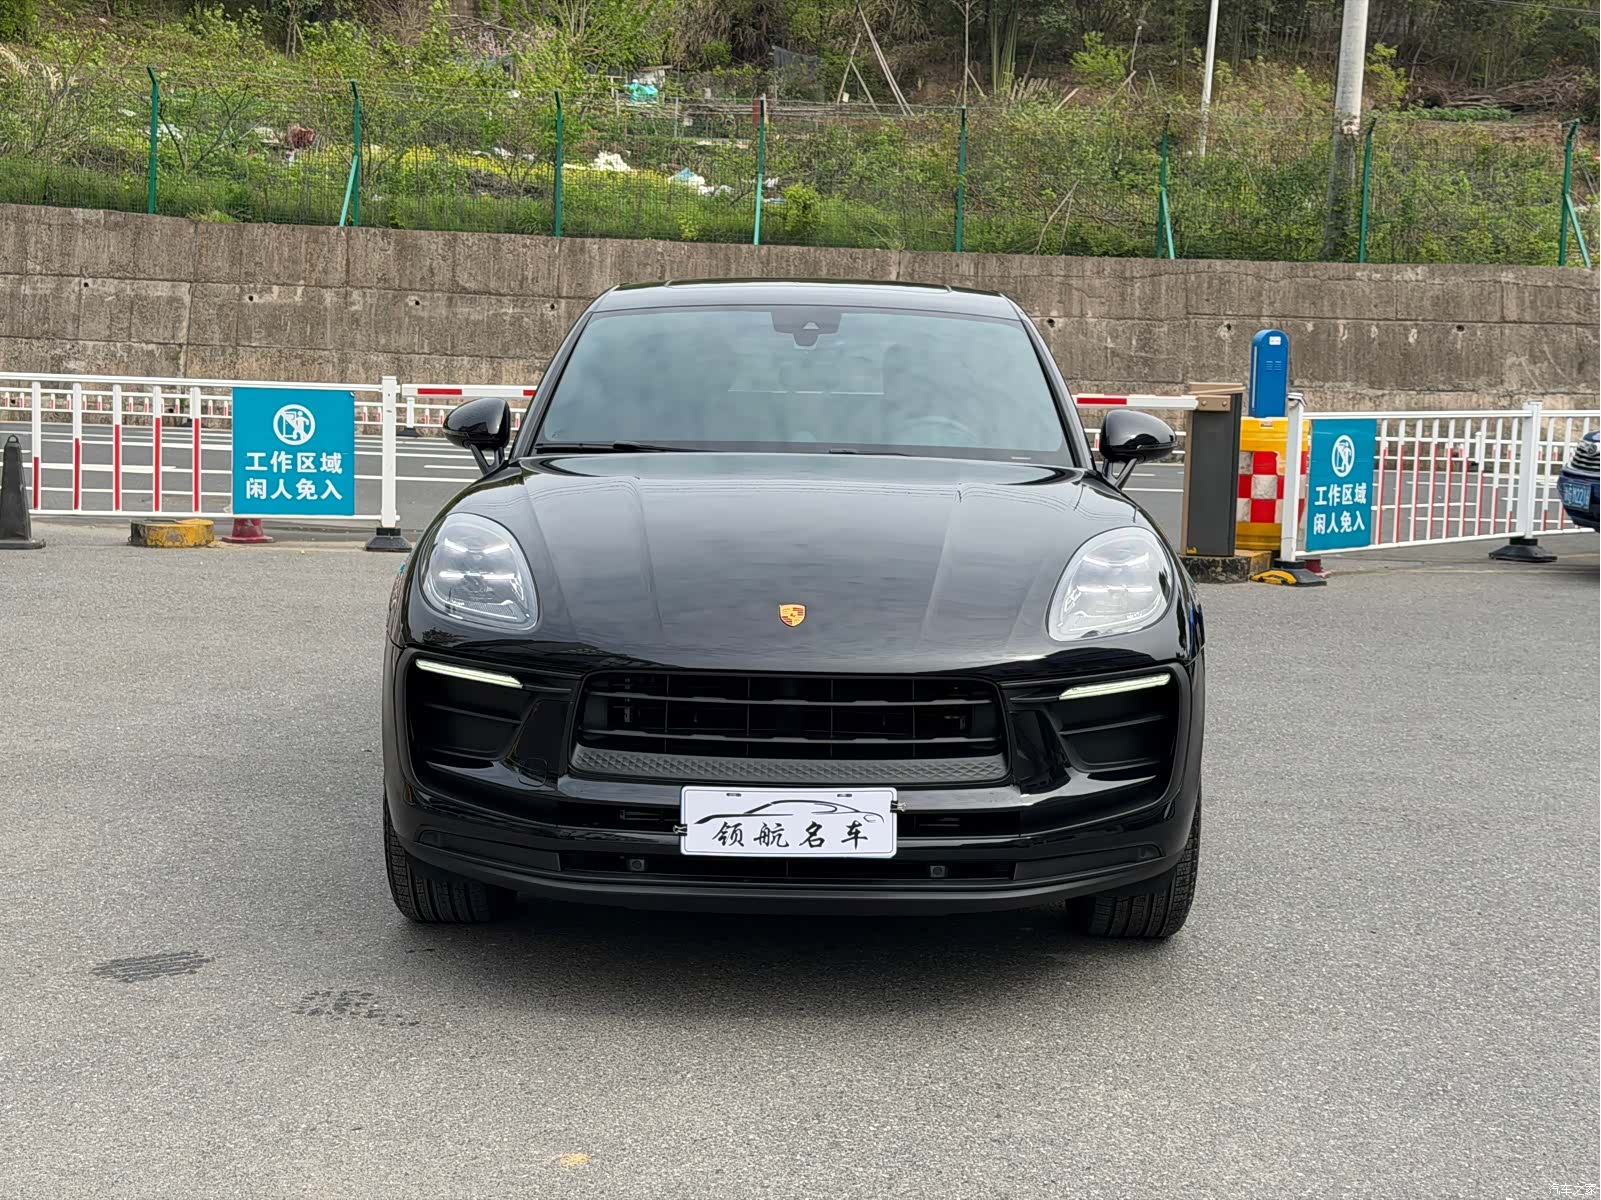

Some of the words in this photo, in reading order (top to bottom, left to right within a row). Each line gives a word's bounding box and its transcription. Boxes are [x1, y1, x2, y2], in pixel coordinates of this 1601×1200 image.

[245, 450, 343, 474] 工作区域
[245, 477, 343, 500] 闲人免入
[1314, 482, 1367, 507] 工作区域
[1313, 510, 1365, 536] 闲人免入
[711, 819, 869, 851] 领航名车
